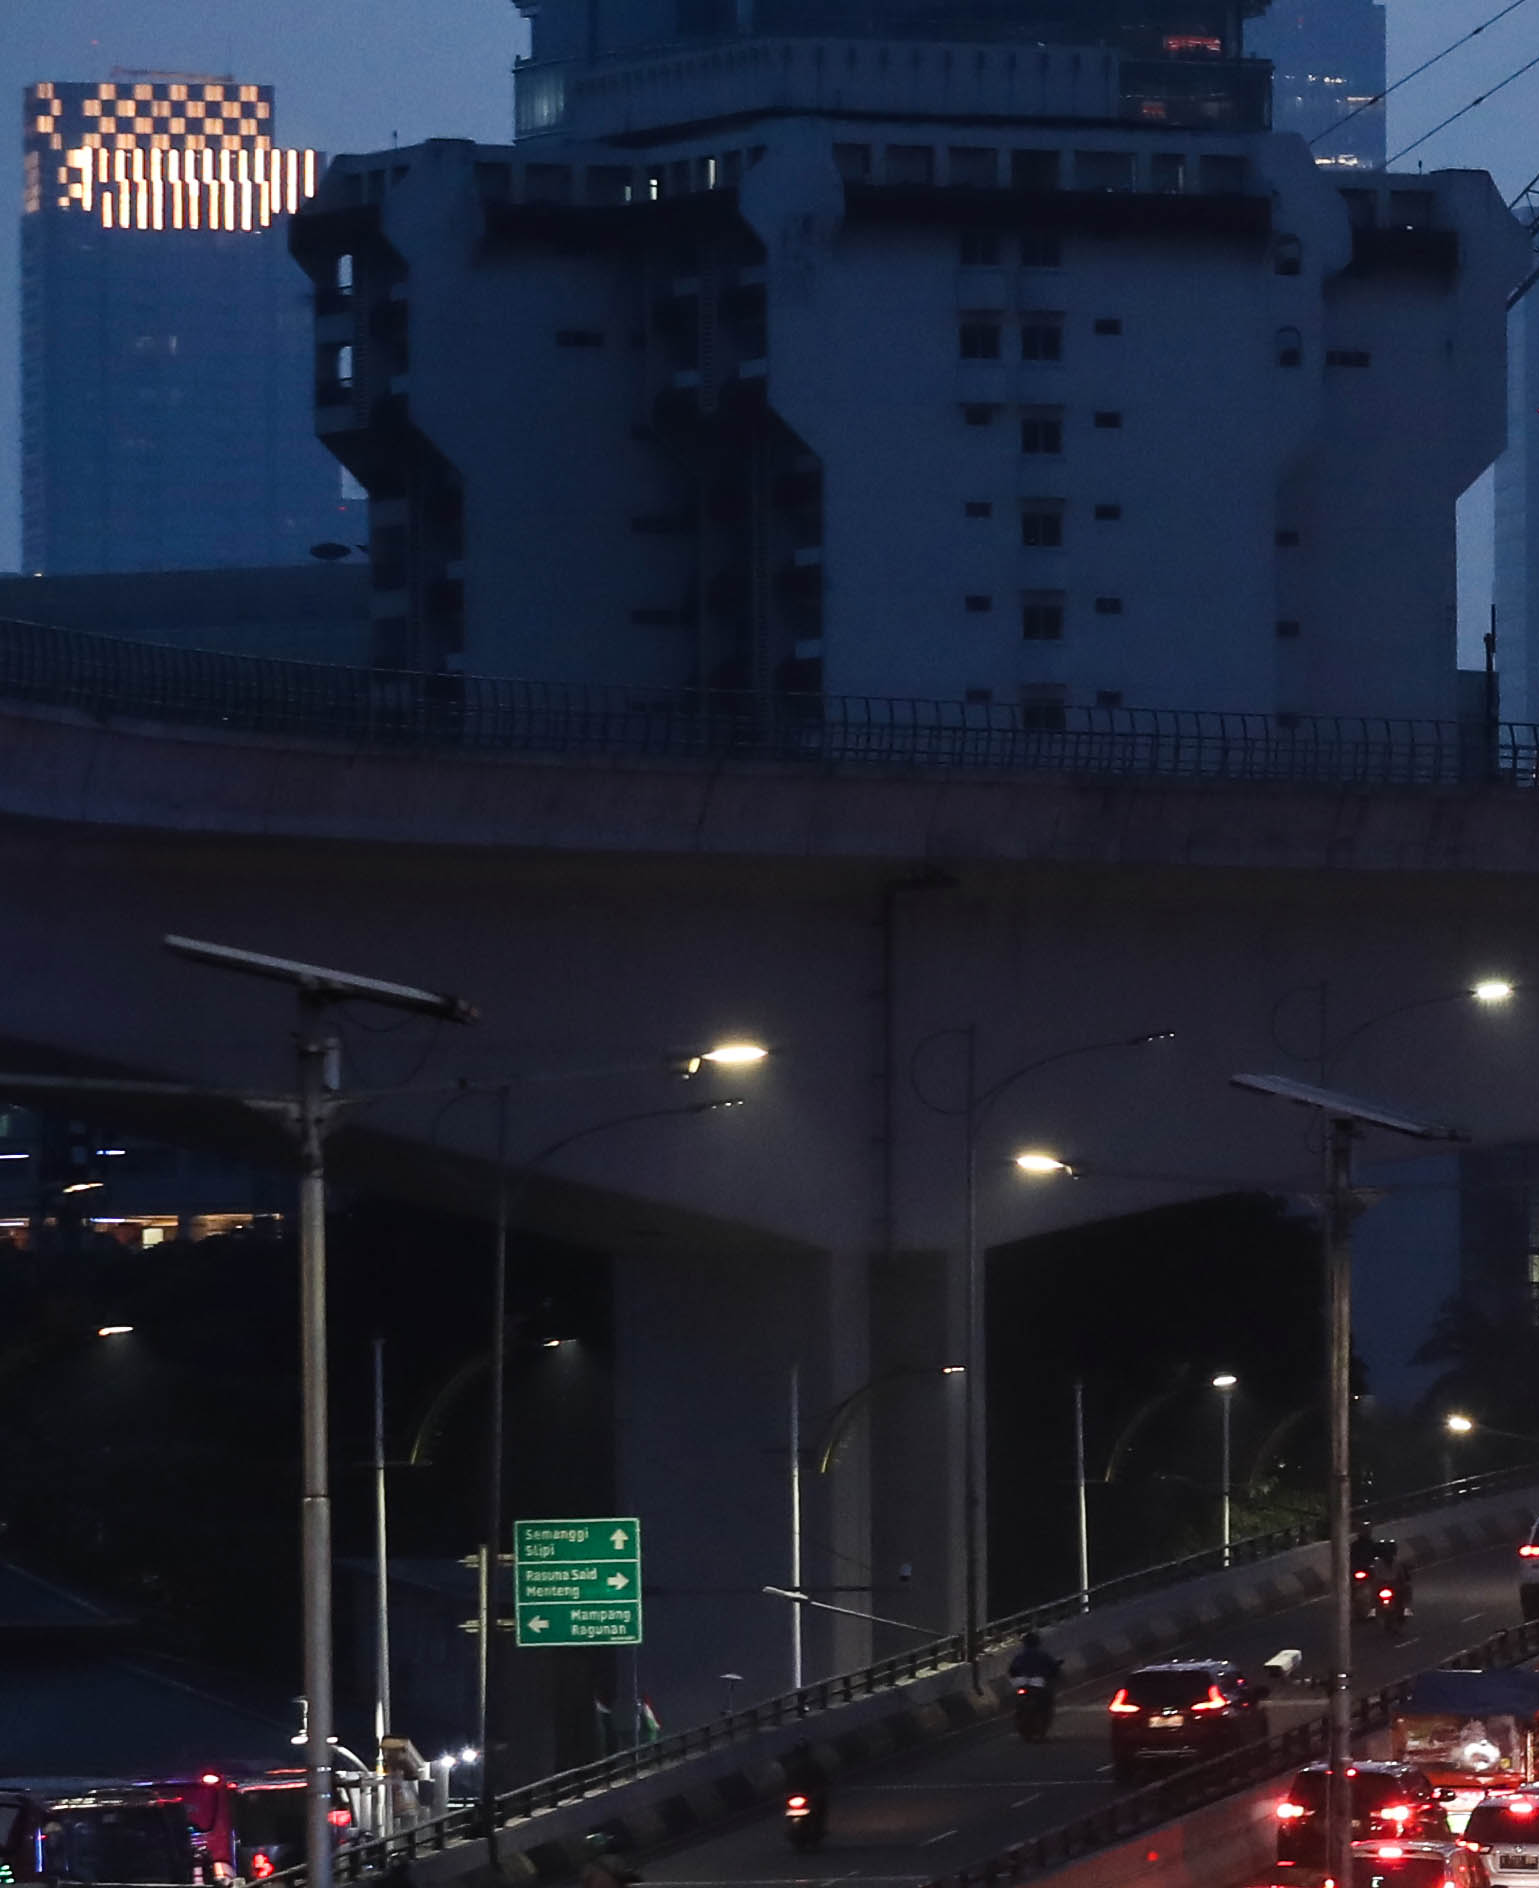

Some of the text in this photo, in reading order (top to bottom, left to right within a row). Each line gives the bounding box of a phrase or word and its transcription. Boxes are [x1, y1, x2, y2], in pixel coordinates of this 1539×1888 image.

[525, 1527, 589, 1542] Semanggi
[525, 1544, 555, 1558] Slipi
[526, 1567, 598, 1581] Rasuna Said
[526, 1586, 580, 1599] Menteng
[571, 1609, 631, 1622] Mampang
[571, 1624, 626, 1637] Ragunan
